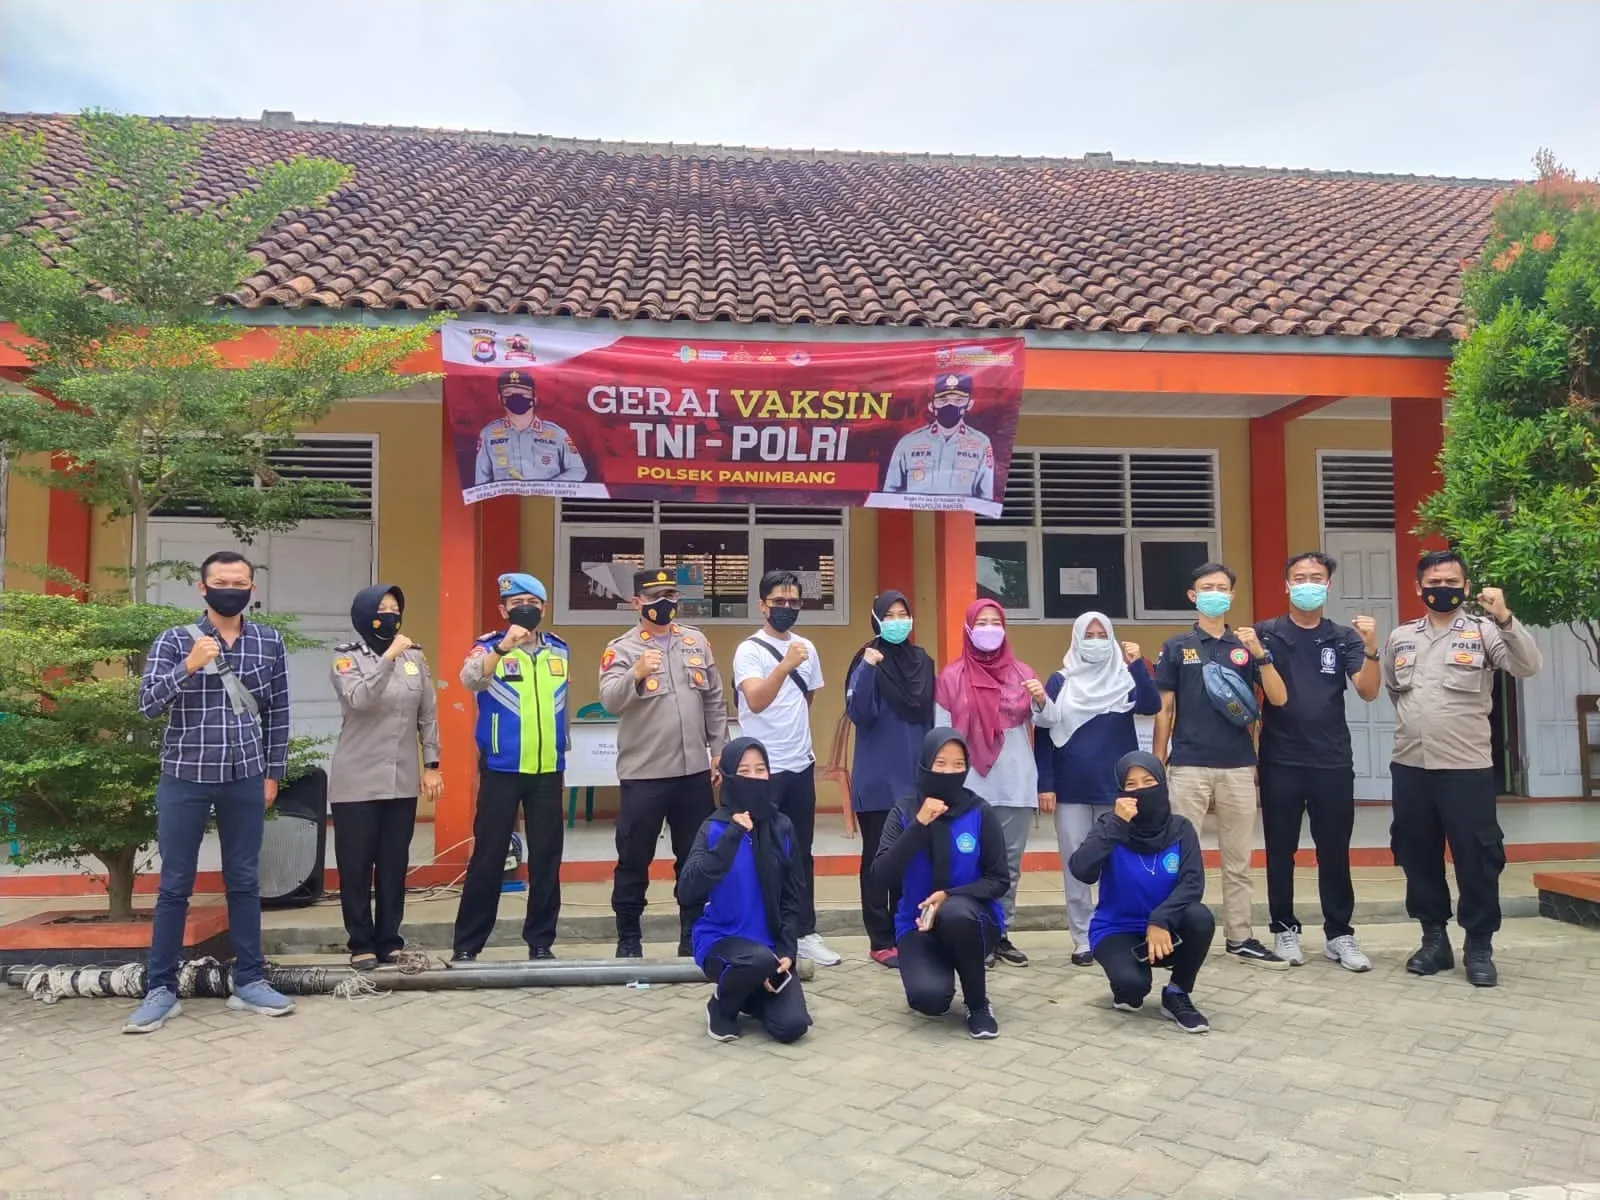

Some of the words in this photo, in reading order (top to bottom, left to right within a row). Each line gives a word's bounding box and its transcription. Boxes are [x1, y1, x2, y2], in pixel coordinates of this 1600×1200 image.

[587, 385, 719, 417] GERAI
[730, 389, 892, 419] VAKSIN
[629, 422, 695, 459] TNI
[705, 439, 722, 447] -
[732, 425, 849, 461] POLRI
[637, 465, 712, 481] POLSEK
[719, 470, 836, 484] PANIMBANG
[1452, 642, 1481, 650] POLRI
